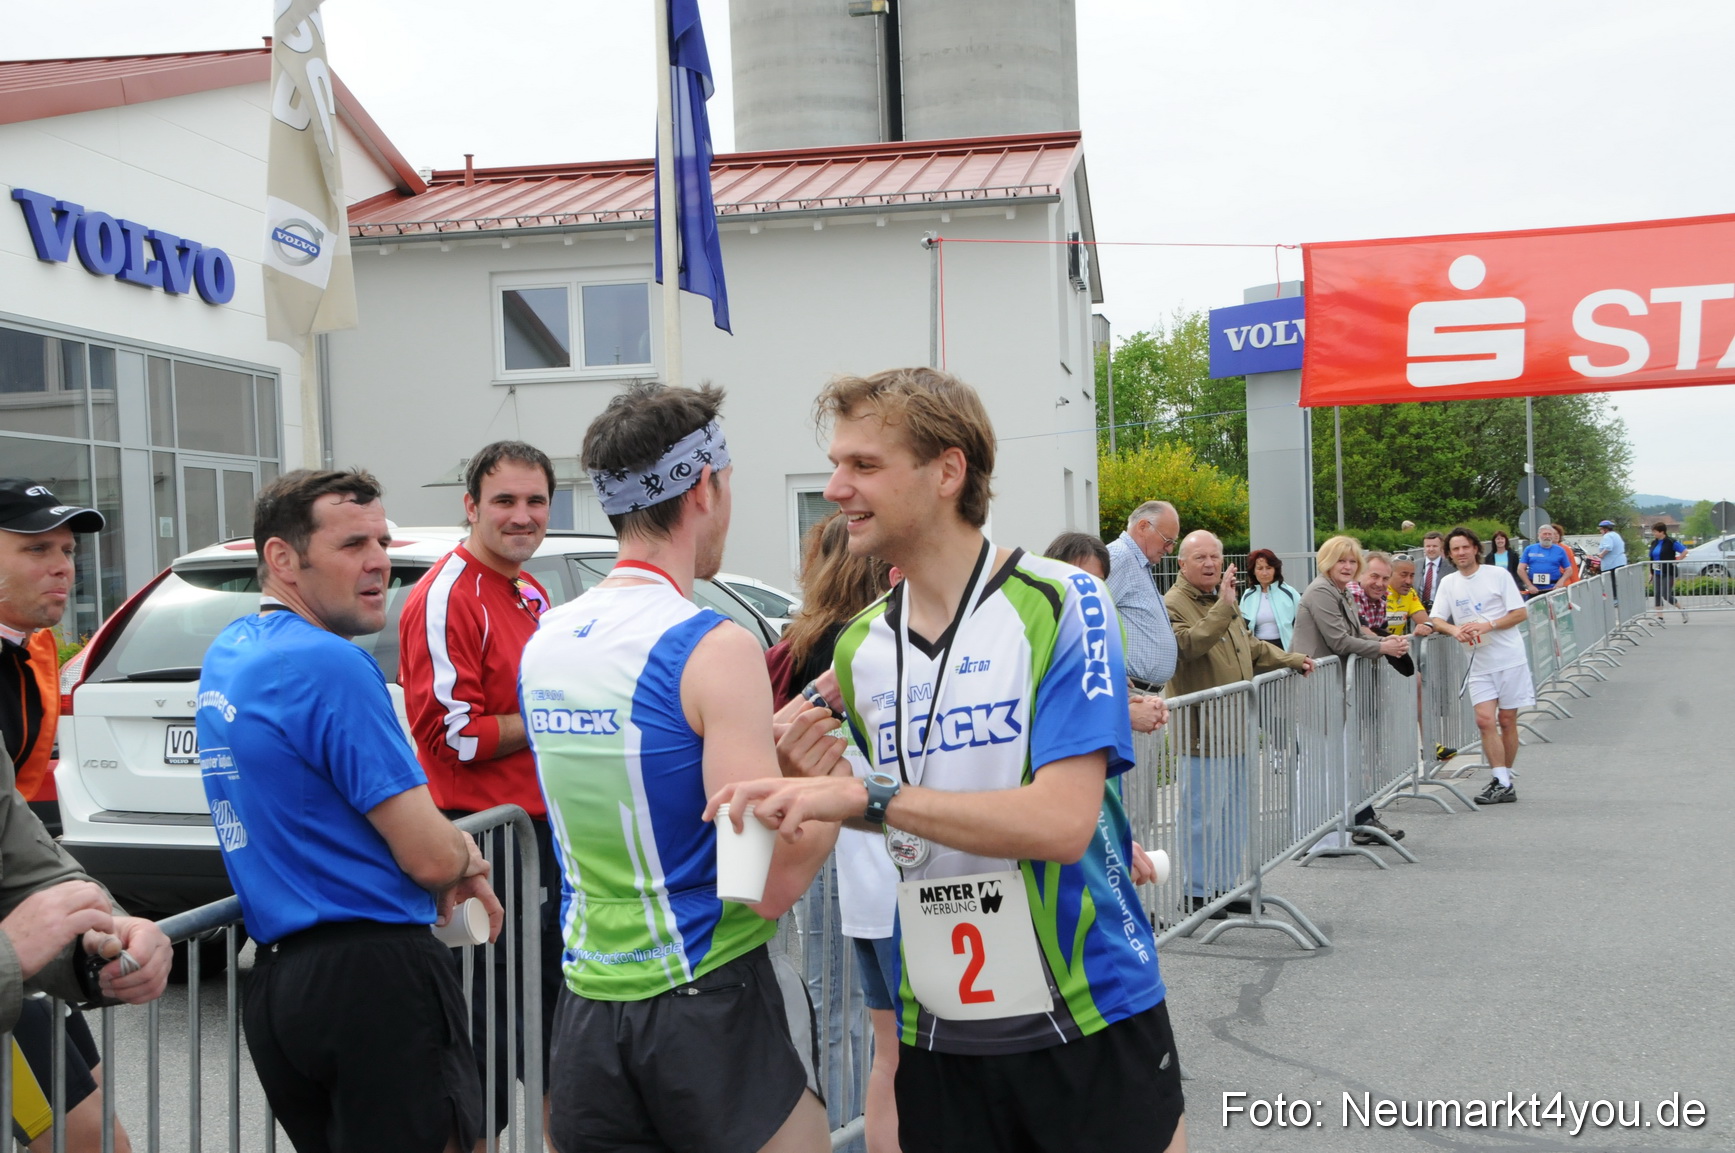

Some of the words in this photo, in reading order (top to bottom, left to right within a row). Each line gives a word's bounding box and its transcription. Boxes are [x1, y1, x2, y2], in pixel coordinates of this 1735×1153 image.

[12, 188, 236, 305] VOLVO
[275, 230, 318, 254] VOLVO
[1568, 283, 1735, 378] ST
[1537, 574, 1546, 583] 19
[1068, 573, 1114, 701] BOCK
[531, 689, 565, 701] TEAM
[531, 708, 621, 735] BOCK
[878, 698, 1022, 766] BOCK
[919, 883, 975, 904] MEYER
[920, 901, 978, 916] WERBUNG
[951, 922, 996, 1005] 2
